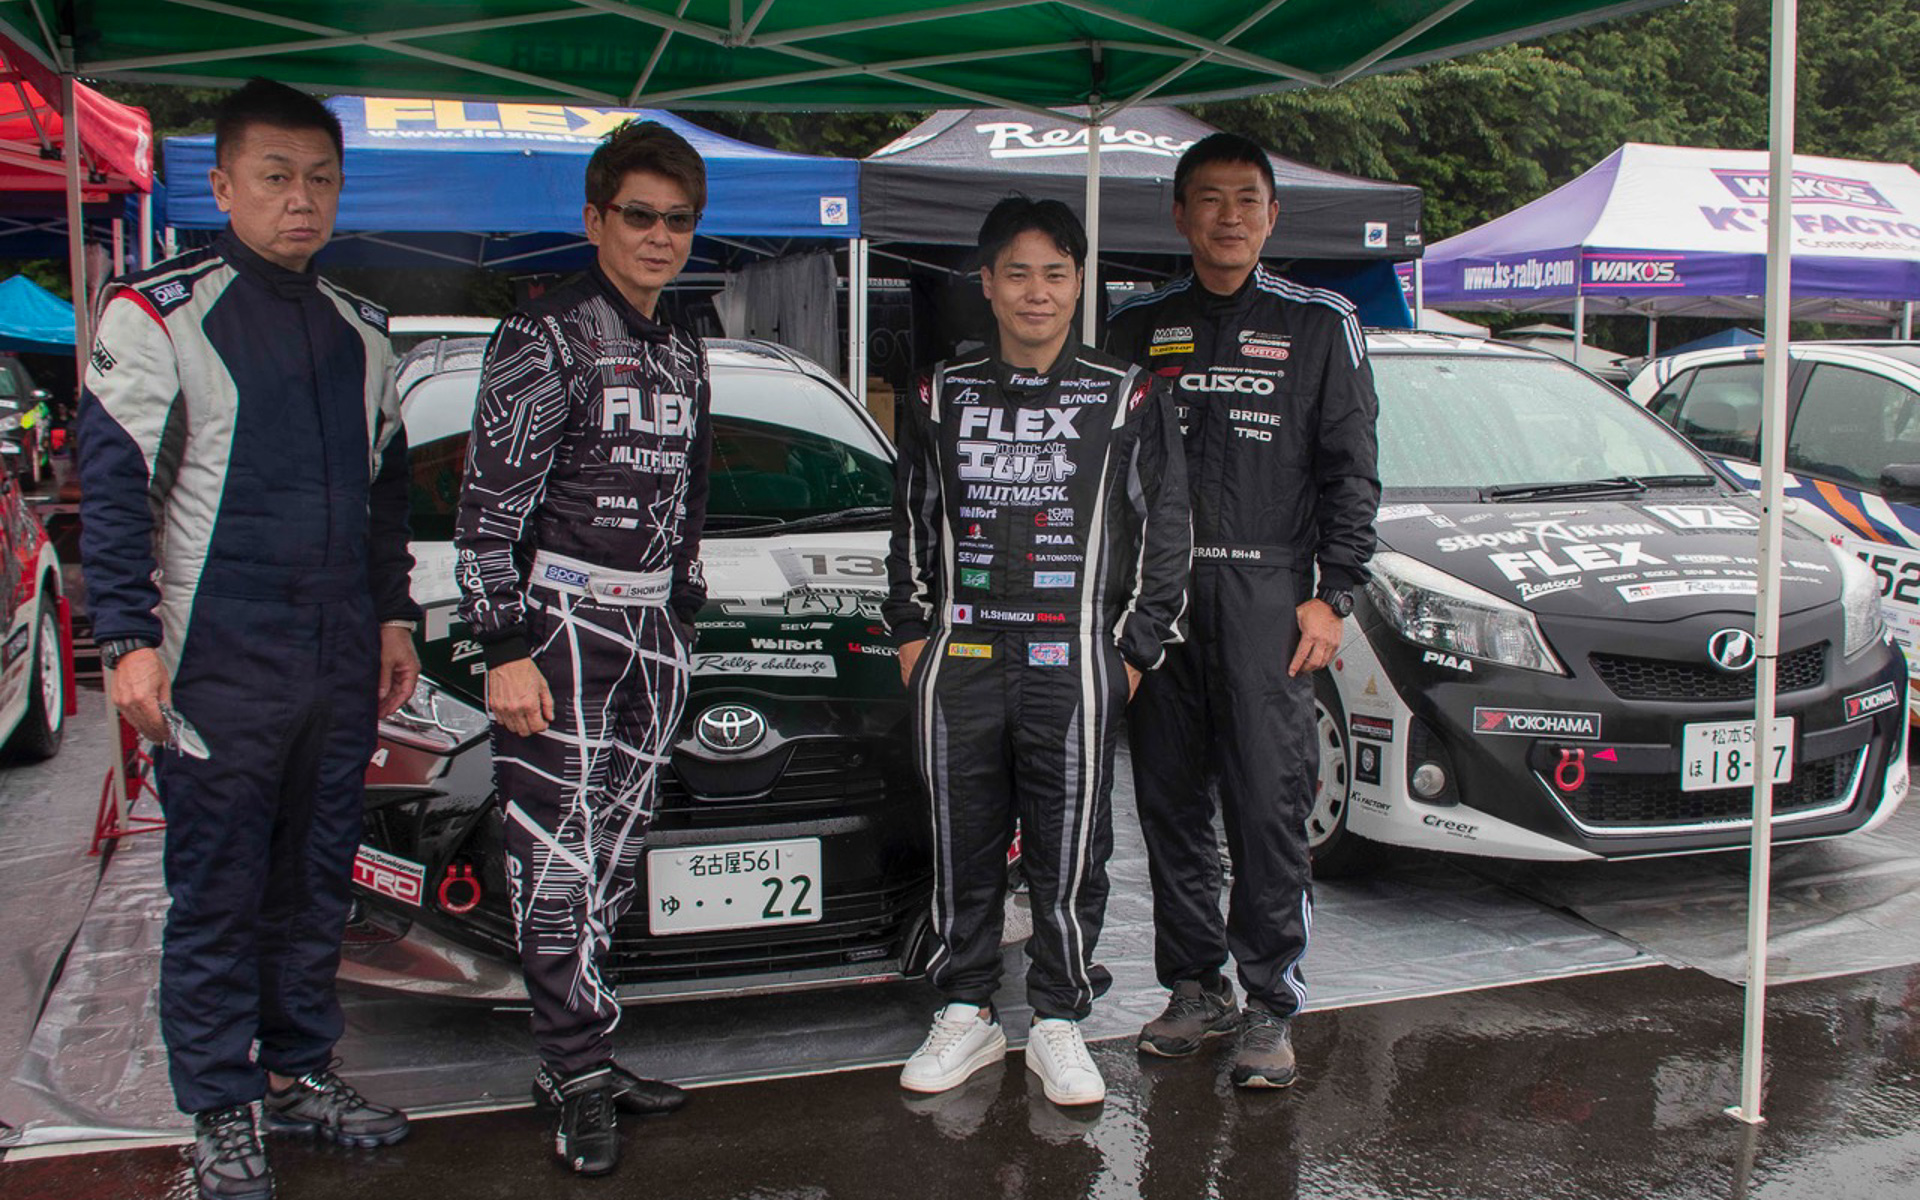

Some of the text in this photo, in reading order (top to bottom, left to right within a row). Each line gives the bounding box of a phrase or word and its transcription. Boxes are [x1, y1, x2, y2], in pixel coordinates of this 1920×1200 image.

[364, 96, 641, 138] FLEX
[1463, 258, 1575, 291] www.ks-rally.com
[1179, 373, 1275, 395] CUSCO
[602, 387, 694, 440] FLEX
[959, 407, 1081, 441] FLEX
[1229, 408, 1282, 426] BRIDE
[1234, 426, 1273, 442] TRD
[597, 496, 638, 510] PIAA
[967, 484, 1068, 501] MLITMASK
[591, 516, 621, 528] SEV
[1035, 535, 1074, 545] PIAA
[1435, 528, 1529, 553] SHOW
[1488, 541, 1669, 582] FLEX
[1857, 551, 1920, 605] 52
[781, 621, 810, 631] SEV
[696, 655, 827, 675] Rally challenge
[1423, 650, 1473, 673] PIAA
[1507, 714, 1593, 734] YOKOHAMA
[1689, 746, 1788, 784] ほ 18-7
[1422, 814, 1480, 834] Creer
[355, 860, 418, 899] TRD
[660, 895, 681, 918] ゆ
[761, 874, 813, 920] 22
